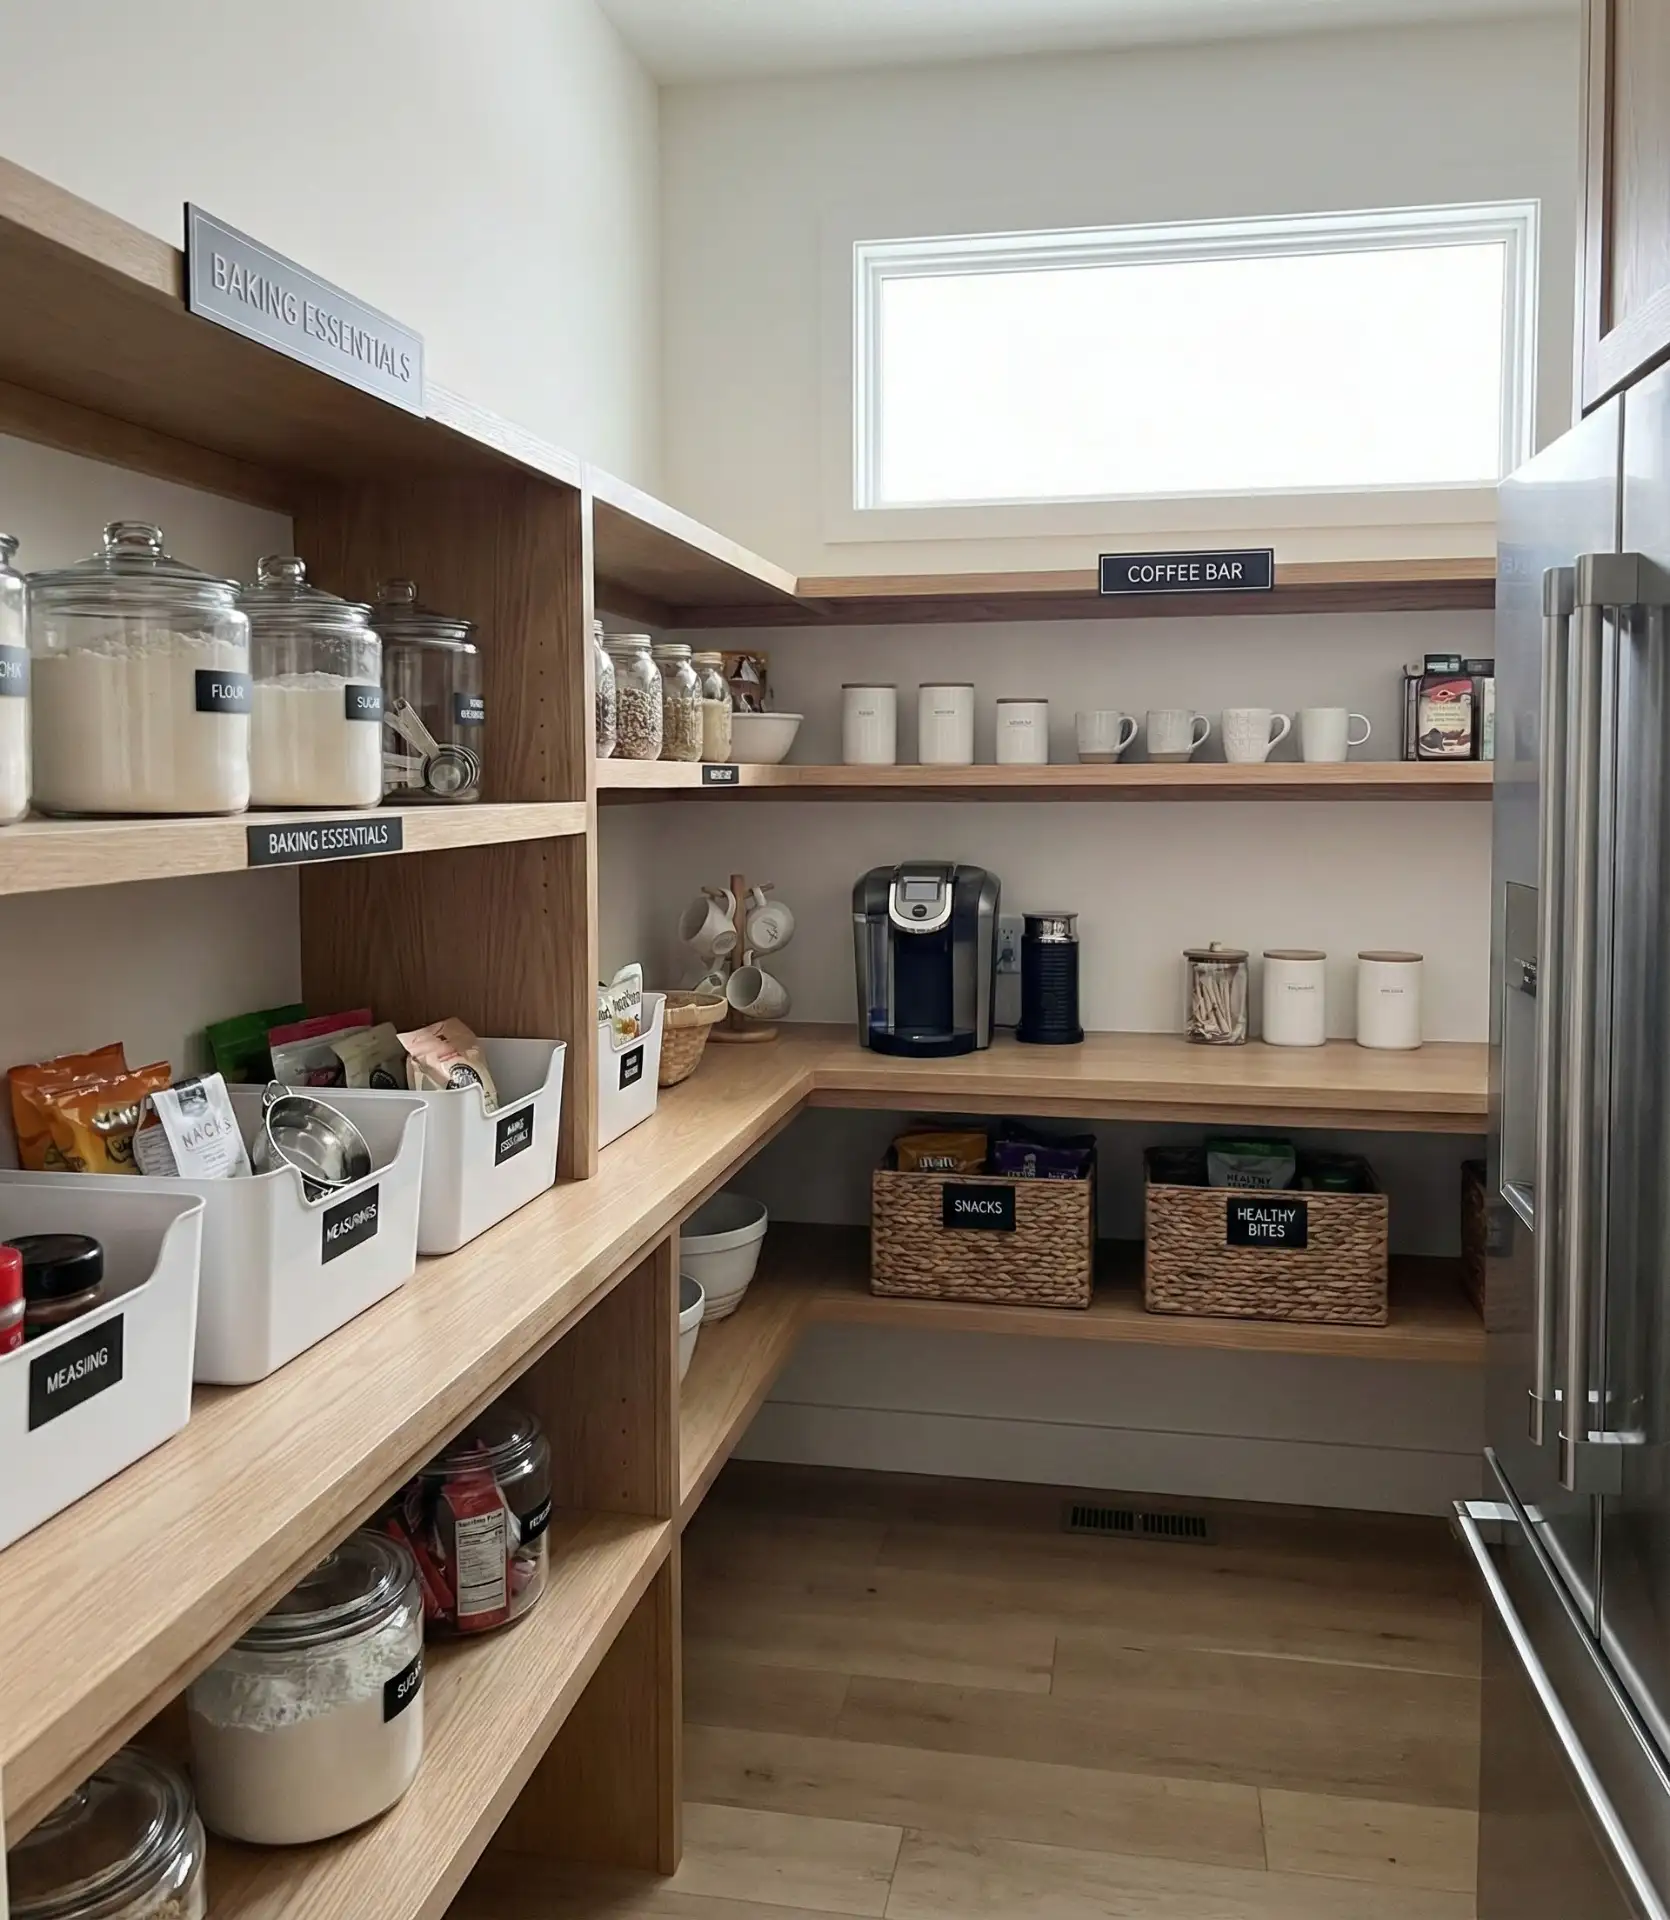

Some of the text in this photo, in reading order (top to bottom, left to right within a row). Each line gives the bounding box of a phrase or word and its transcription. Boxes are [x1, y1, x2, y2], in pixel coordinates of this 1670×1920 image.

[211, 252, 410, 383] BAKING ESSENTIALS
[1127, 562, 1243, 583] COFFEE BAR
[212, 683, 244, 700] FLOUR
[269, 824, 388, 854] BAKING ESSENTIALS
[954, 1199, 1003, 1215] SNACKS
[1237, 1207, 1296, 1223] HEALTHY
[1248, 1222, 1286, 1238] BITES
